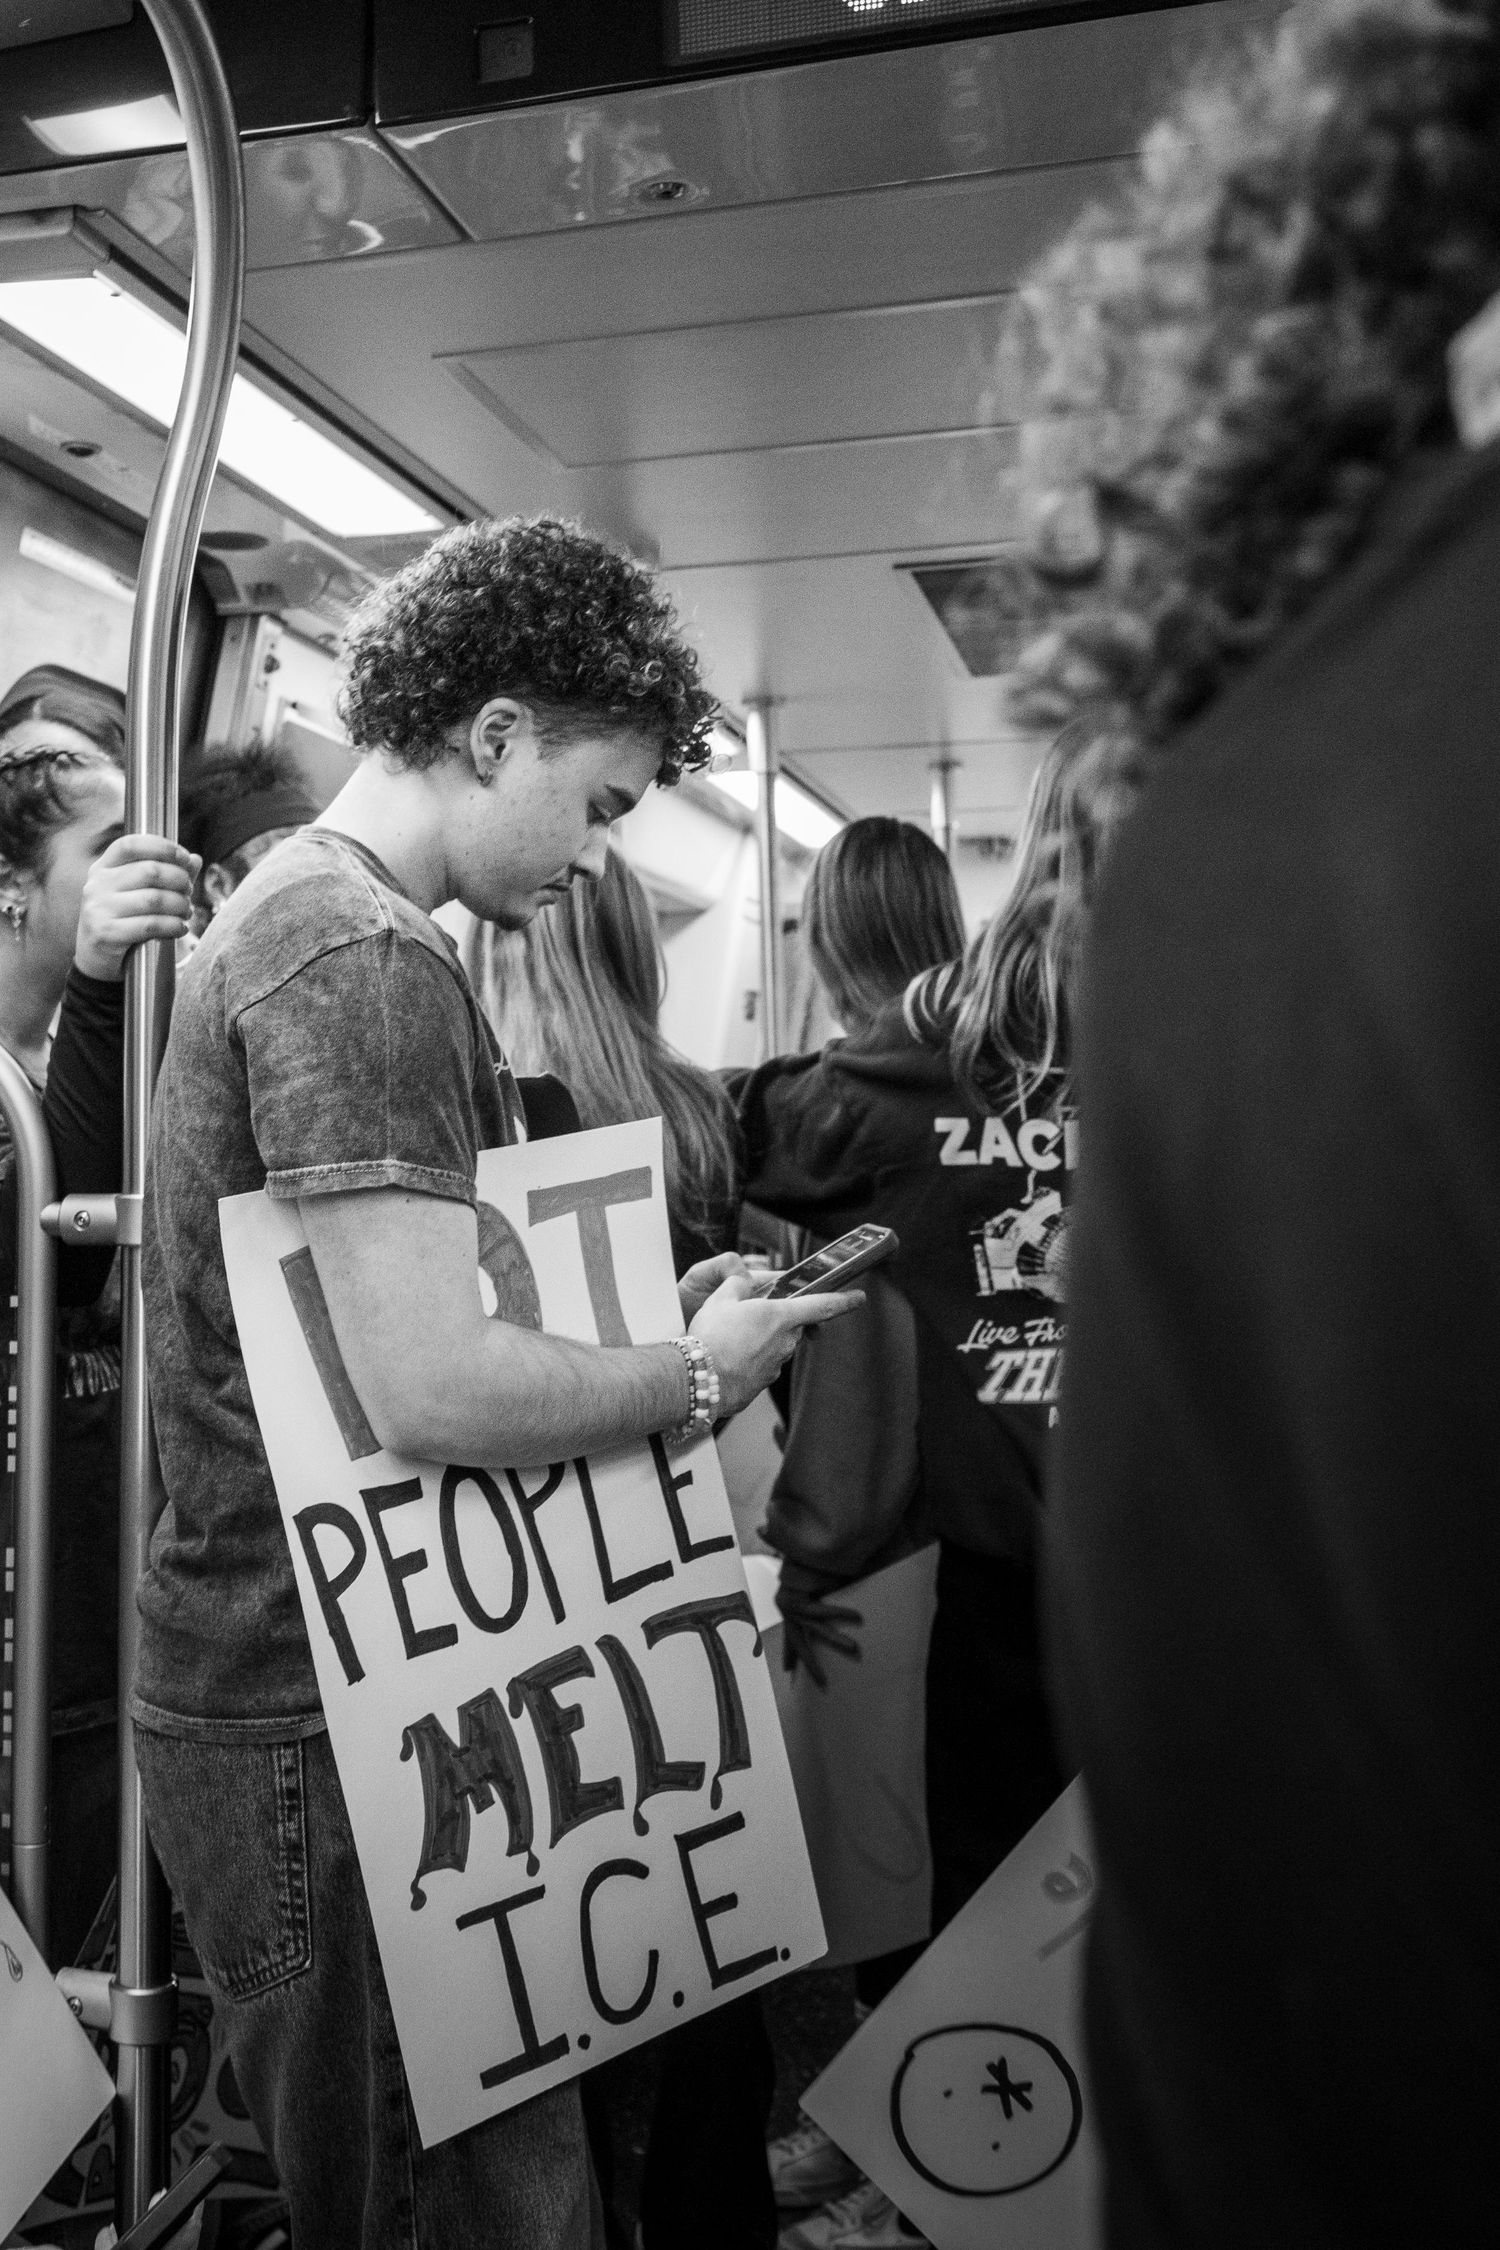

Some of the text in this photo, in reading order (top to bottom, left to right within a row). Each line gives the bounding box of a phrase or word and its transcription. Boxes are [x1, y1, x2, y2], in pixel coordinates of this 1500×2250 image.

[956, 1318, 1020, 1353] Live
[293, 1433, 734, 1686] PEOPLE
[400, 1591, 763, 1910] MELT
[456, 1811, 790, 2089] I.C.E.
